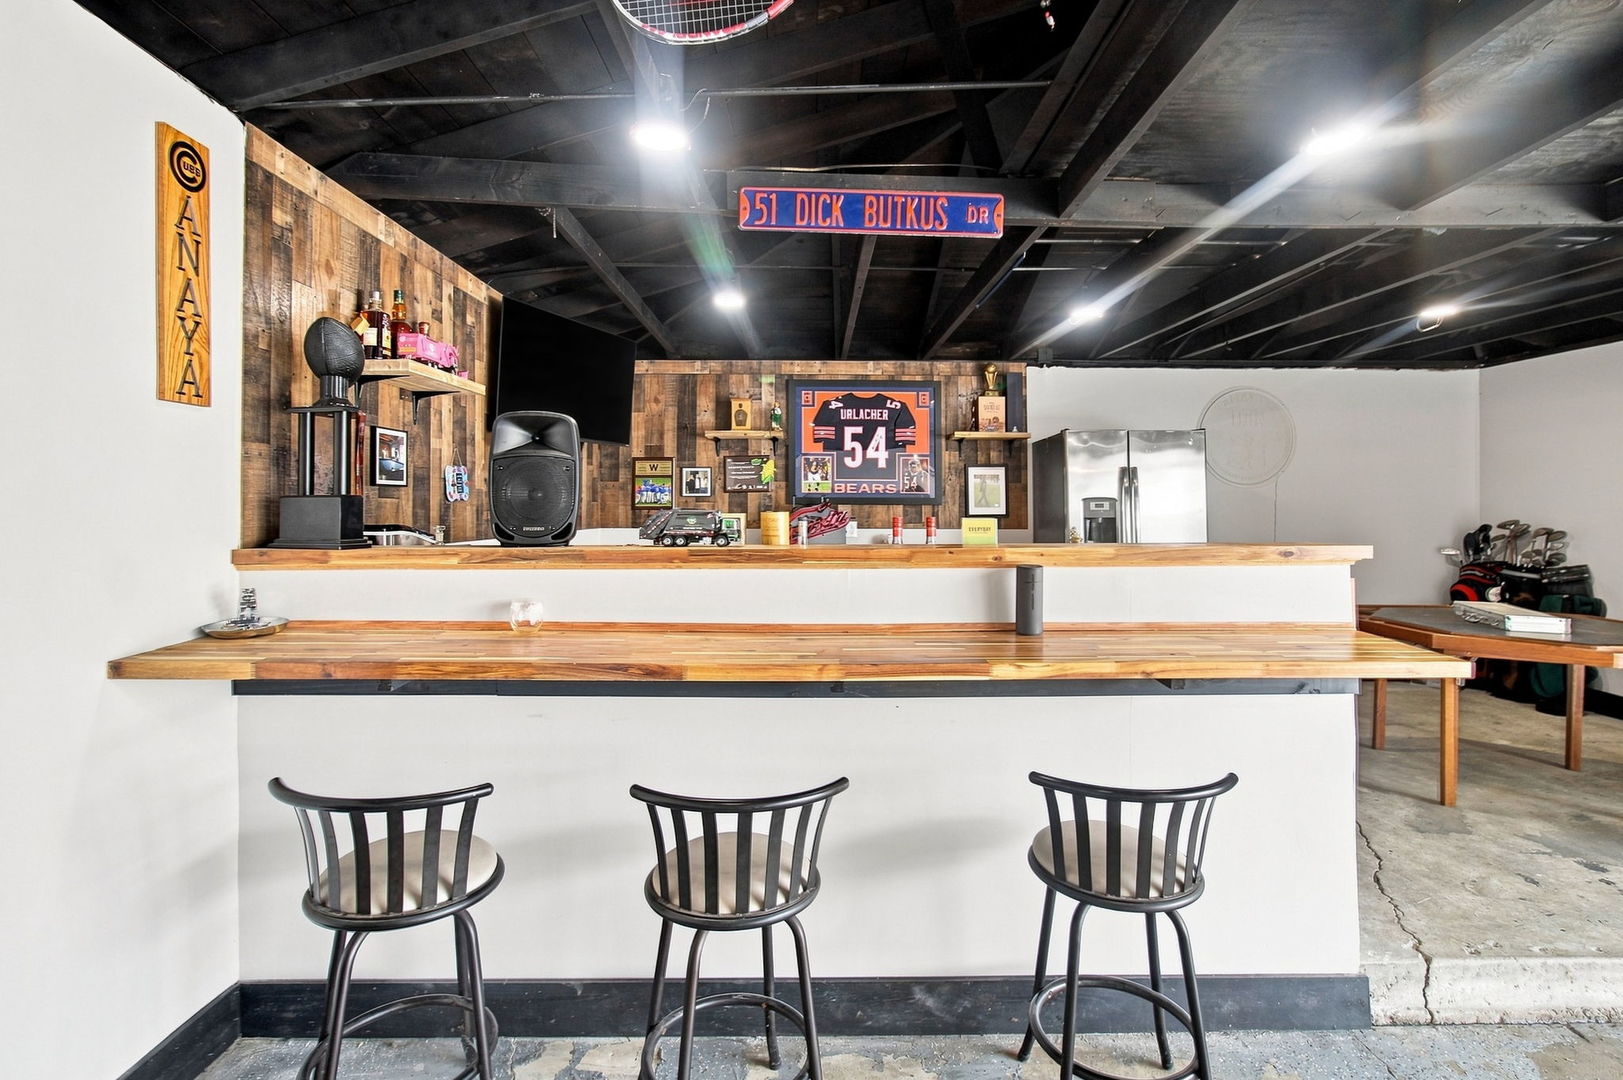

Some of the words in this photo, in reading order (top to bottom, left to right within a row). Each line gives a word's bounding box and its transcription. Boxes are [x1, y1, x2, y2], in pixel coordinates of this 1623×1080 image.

[754, 192, 778, 225] 51
[794, 193, 844, 227] DICK
[863, 195, 949, 230] BUTKUS
[966, 203, 989, 225] DR
[173, 194, 203, 399] ANAYA
[840, 408, 889, 421] URLACHER
[843, 425, 889, 469] 54
[649, 463, 659, 472] W
[834, 482, 898, 494] BEARS
[903, 474, 918, 489] 54
